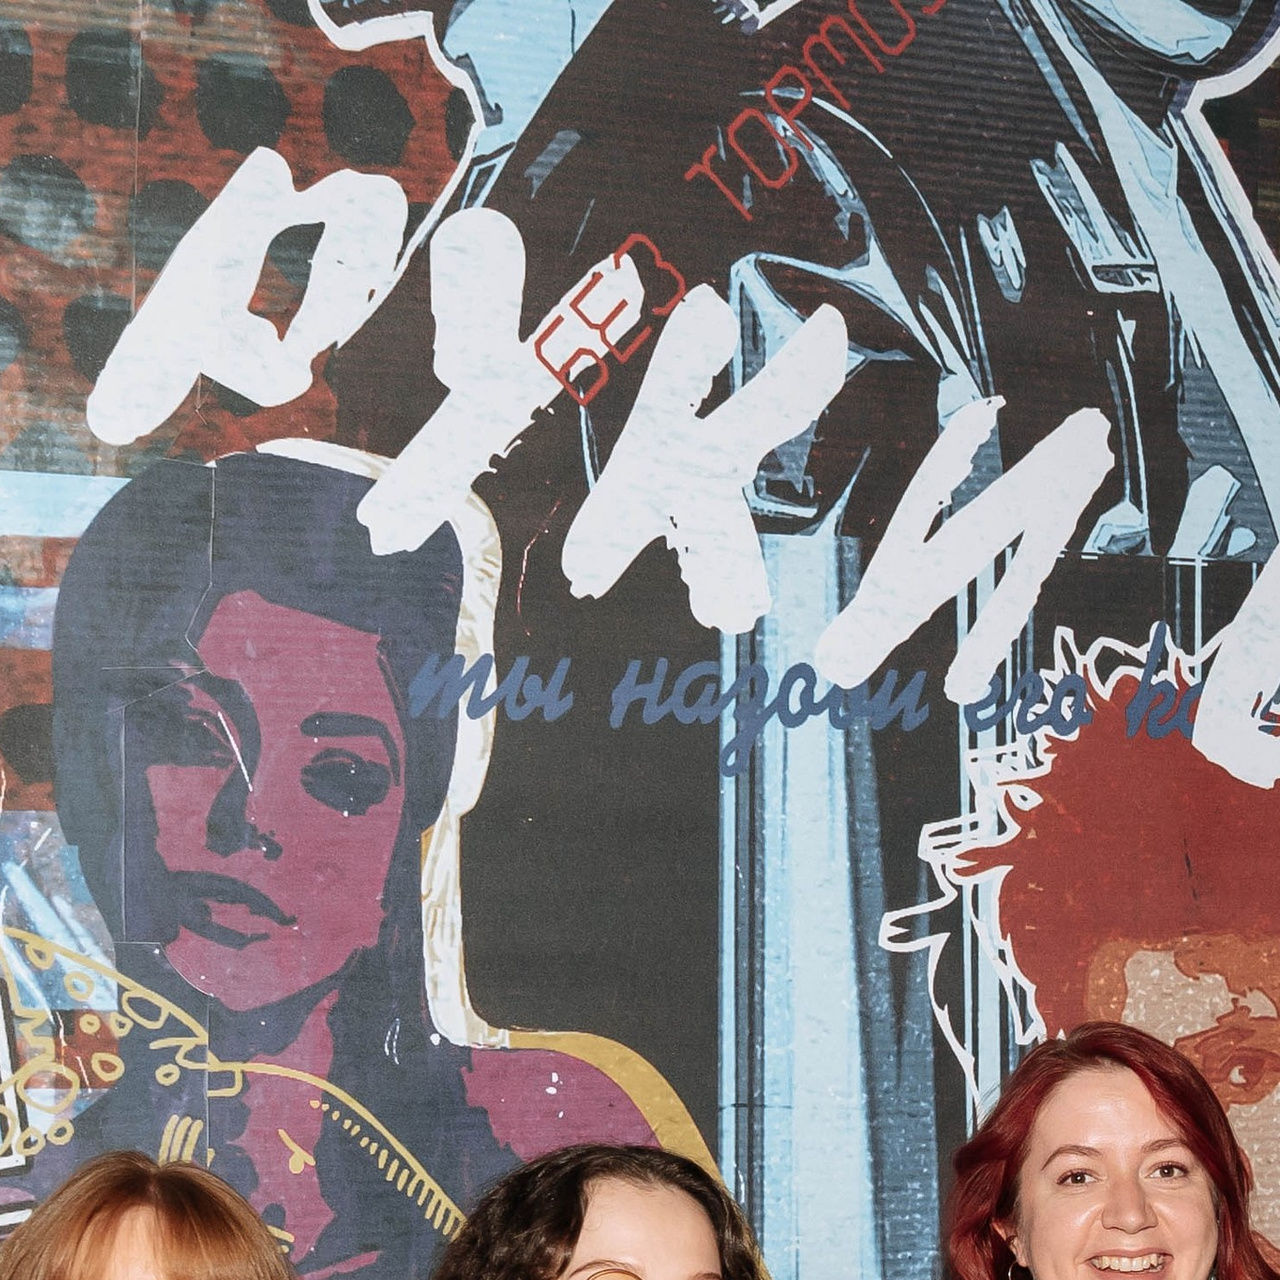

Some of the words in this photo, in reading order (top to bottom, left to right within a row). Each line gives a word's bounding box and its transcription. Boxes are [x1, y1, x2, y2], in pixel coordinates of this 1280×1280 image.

[534, 233, 686, 406] БЕЗ
[684, 0, 948, 221] ТОРМО
[87, 146, 1115, 702] РУКИ
[408, 652, 574, 721] ты
